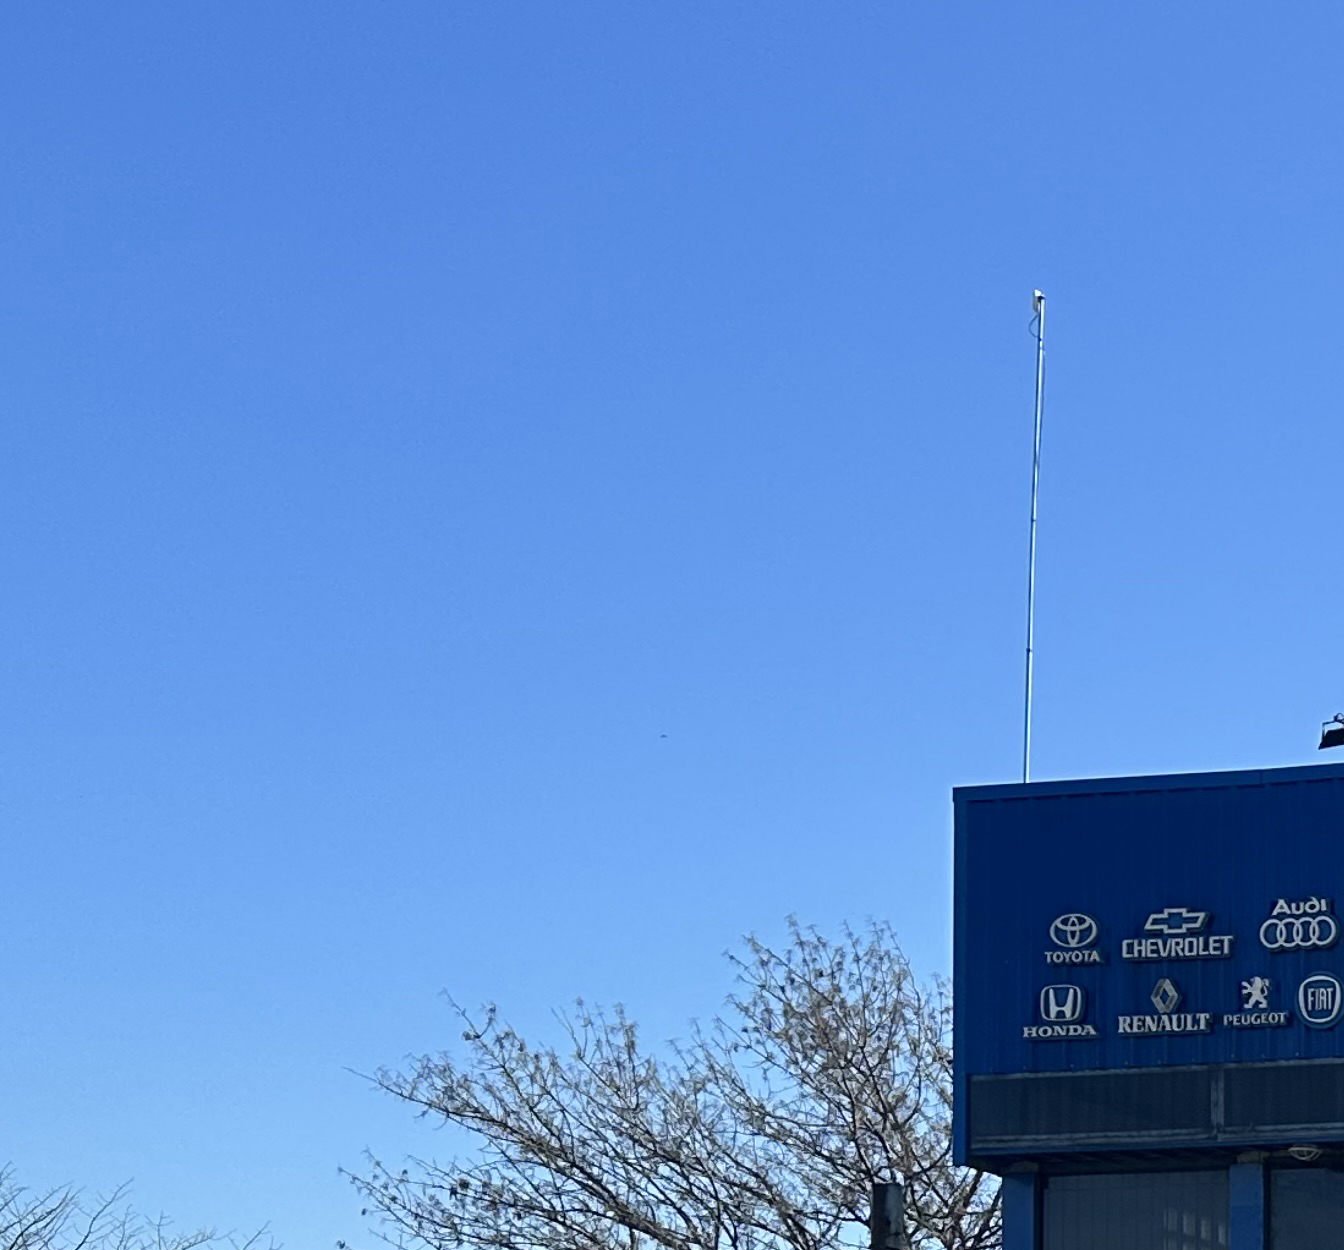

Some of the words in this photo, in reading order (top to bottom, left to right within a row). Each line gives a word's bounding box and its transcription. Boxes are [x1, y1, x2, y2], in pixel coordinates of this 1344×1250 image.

[1272, 898, 1327, 916] Audi
[1122, 935, 1233, 959] CHEVROLET
[1045, 950, 1101, 964] TOYOTA
[1307, 988, 1335, 1011] FIAT
[1118, 1013, 1210, 1033] RENAULT
[1223, 1012, 1287, 1026] PEUGEOT
[1023, 1024, 1097, 1038] HONDA
